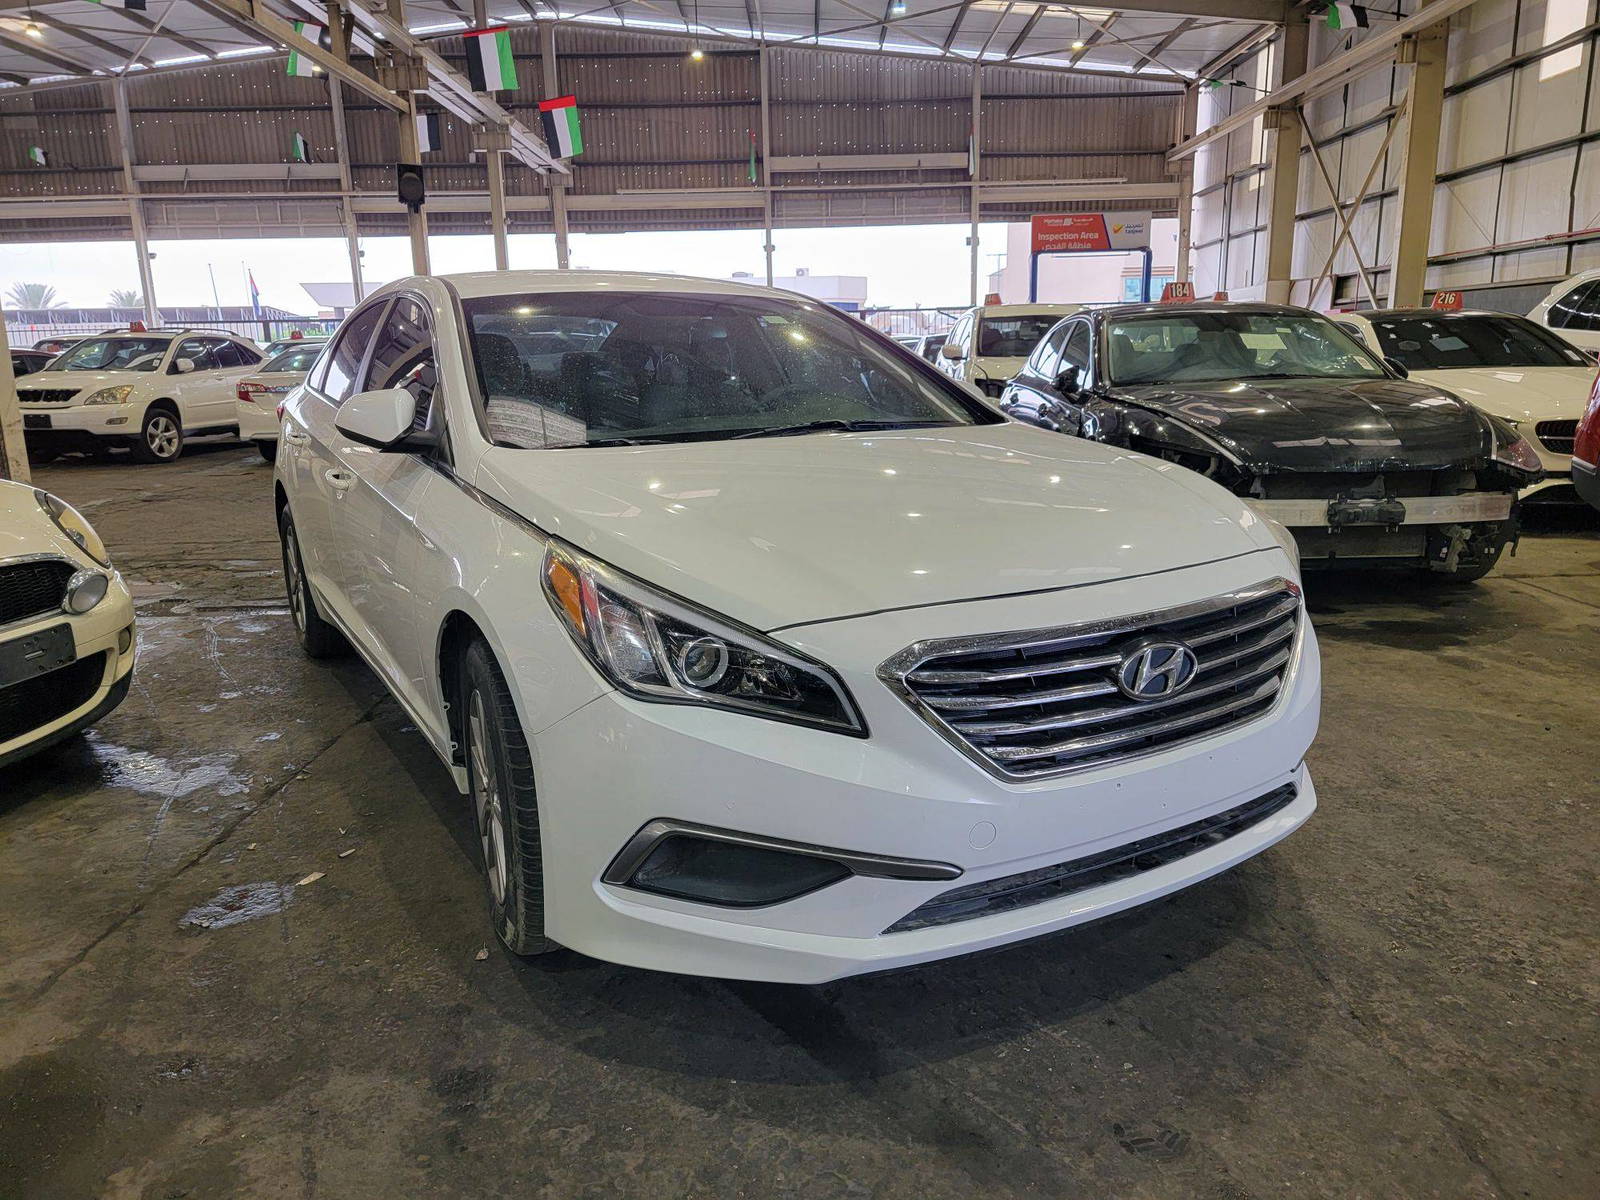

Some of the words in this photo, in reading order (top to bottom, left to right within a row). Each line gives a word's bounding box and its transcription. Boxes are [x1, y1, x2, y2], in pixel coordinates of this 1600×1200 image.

[1038, 232, 1078, 241] Inspection
[1171, 283, 1189, 297] 184
[1438, 292, 1456, 304] 216
